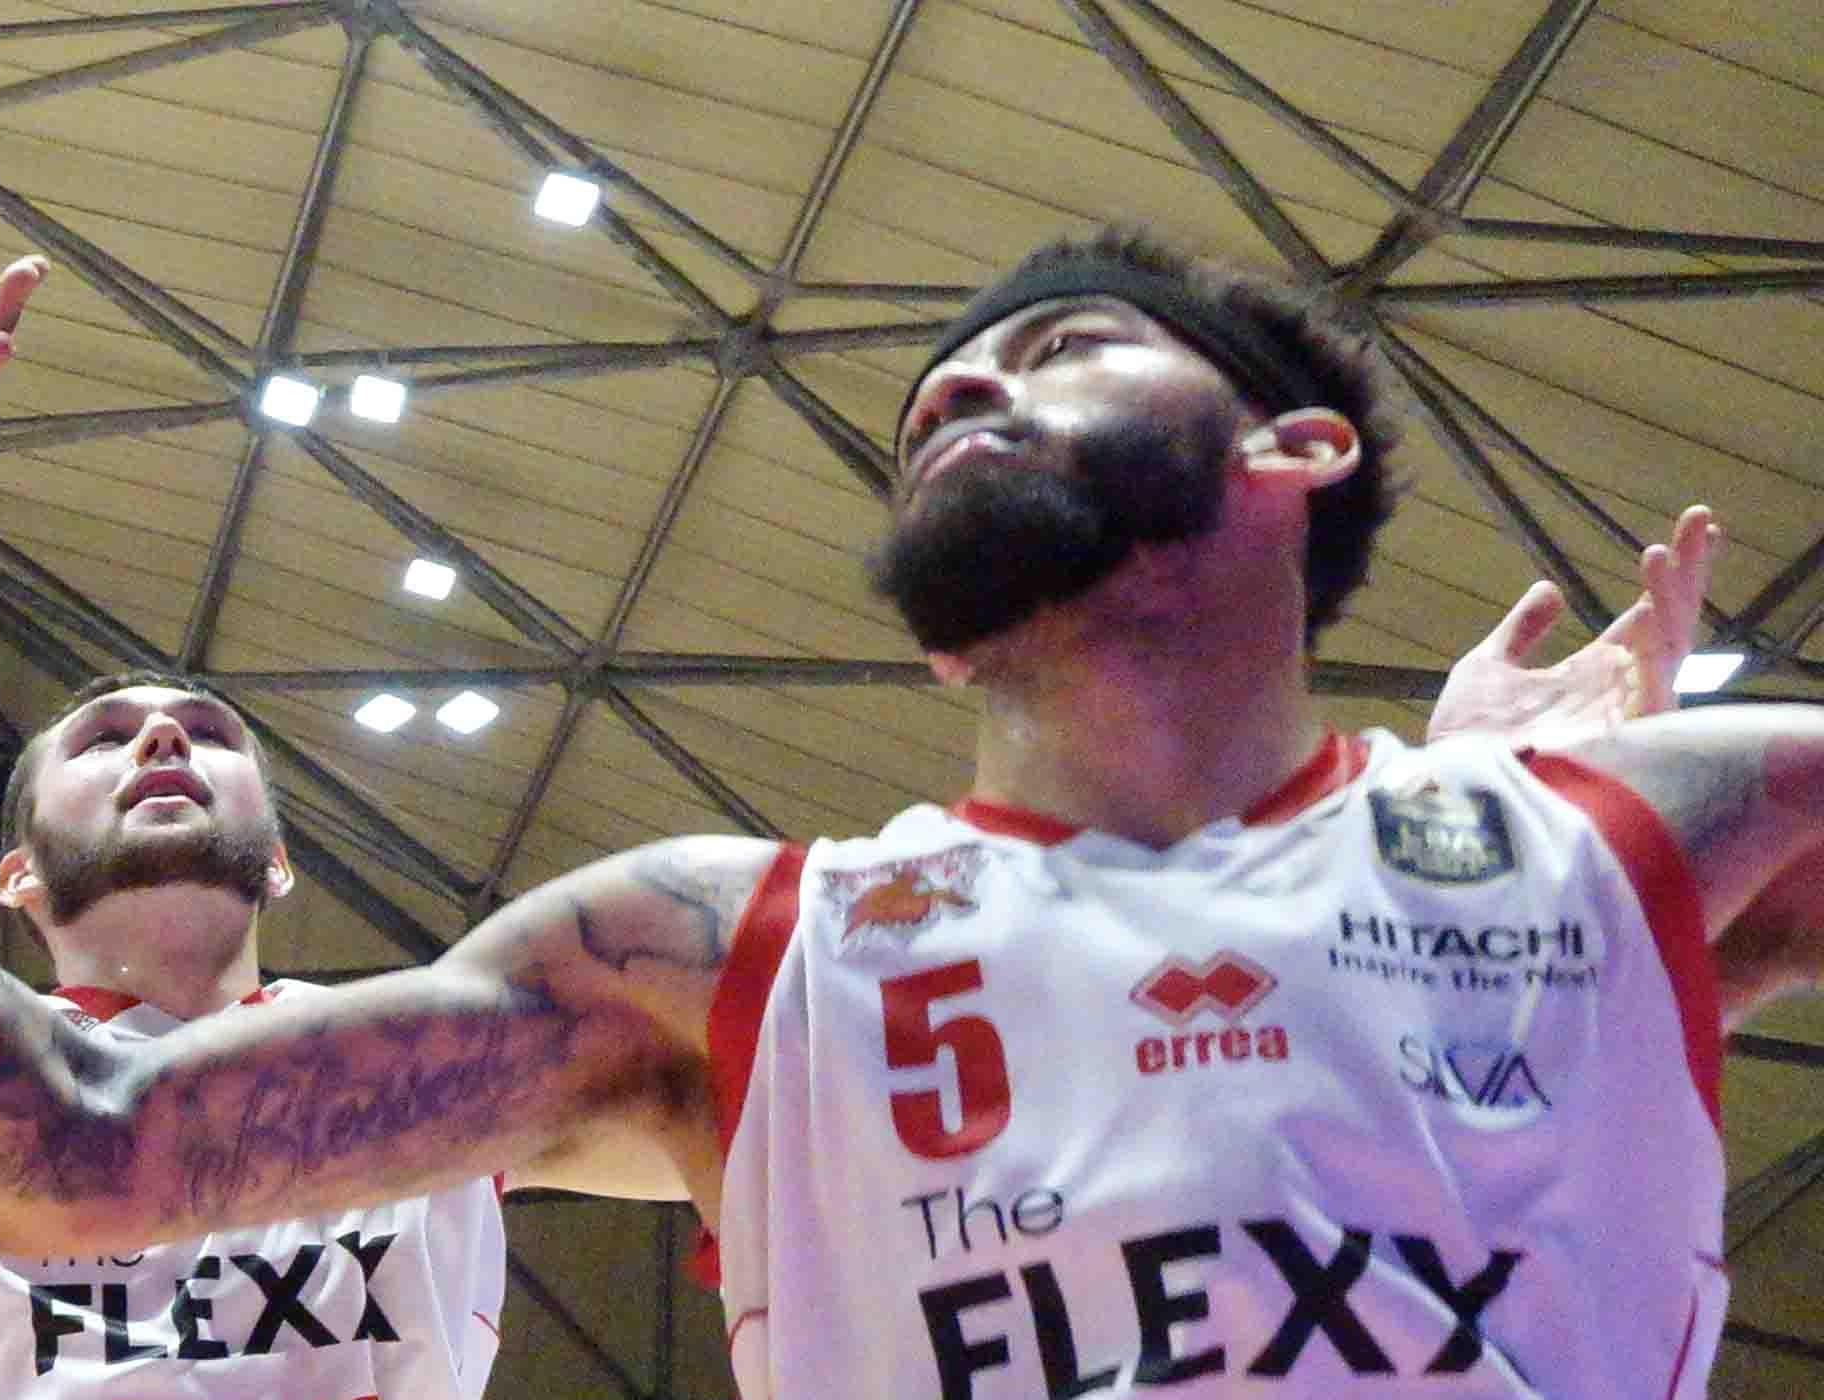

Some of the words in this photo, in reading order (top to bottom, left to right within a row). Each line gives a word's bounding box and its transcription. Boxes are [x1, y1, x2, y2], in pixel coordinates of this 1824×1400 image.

[1340, 912, 1583, 960] HITACHI
[1453, 966, 1510, 990] the
[879, 958, 1012, 1162] 5
[1134, 1027, 1288, 1075] errea
[903, 1188, 1064, 1260] The
[30, 1231, 401, 1376] FLEXX
